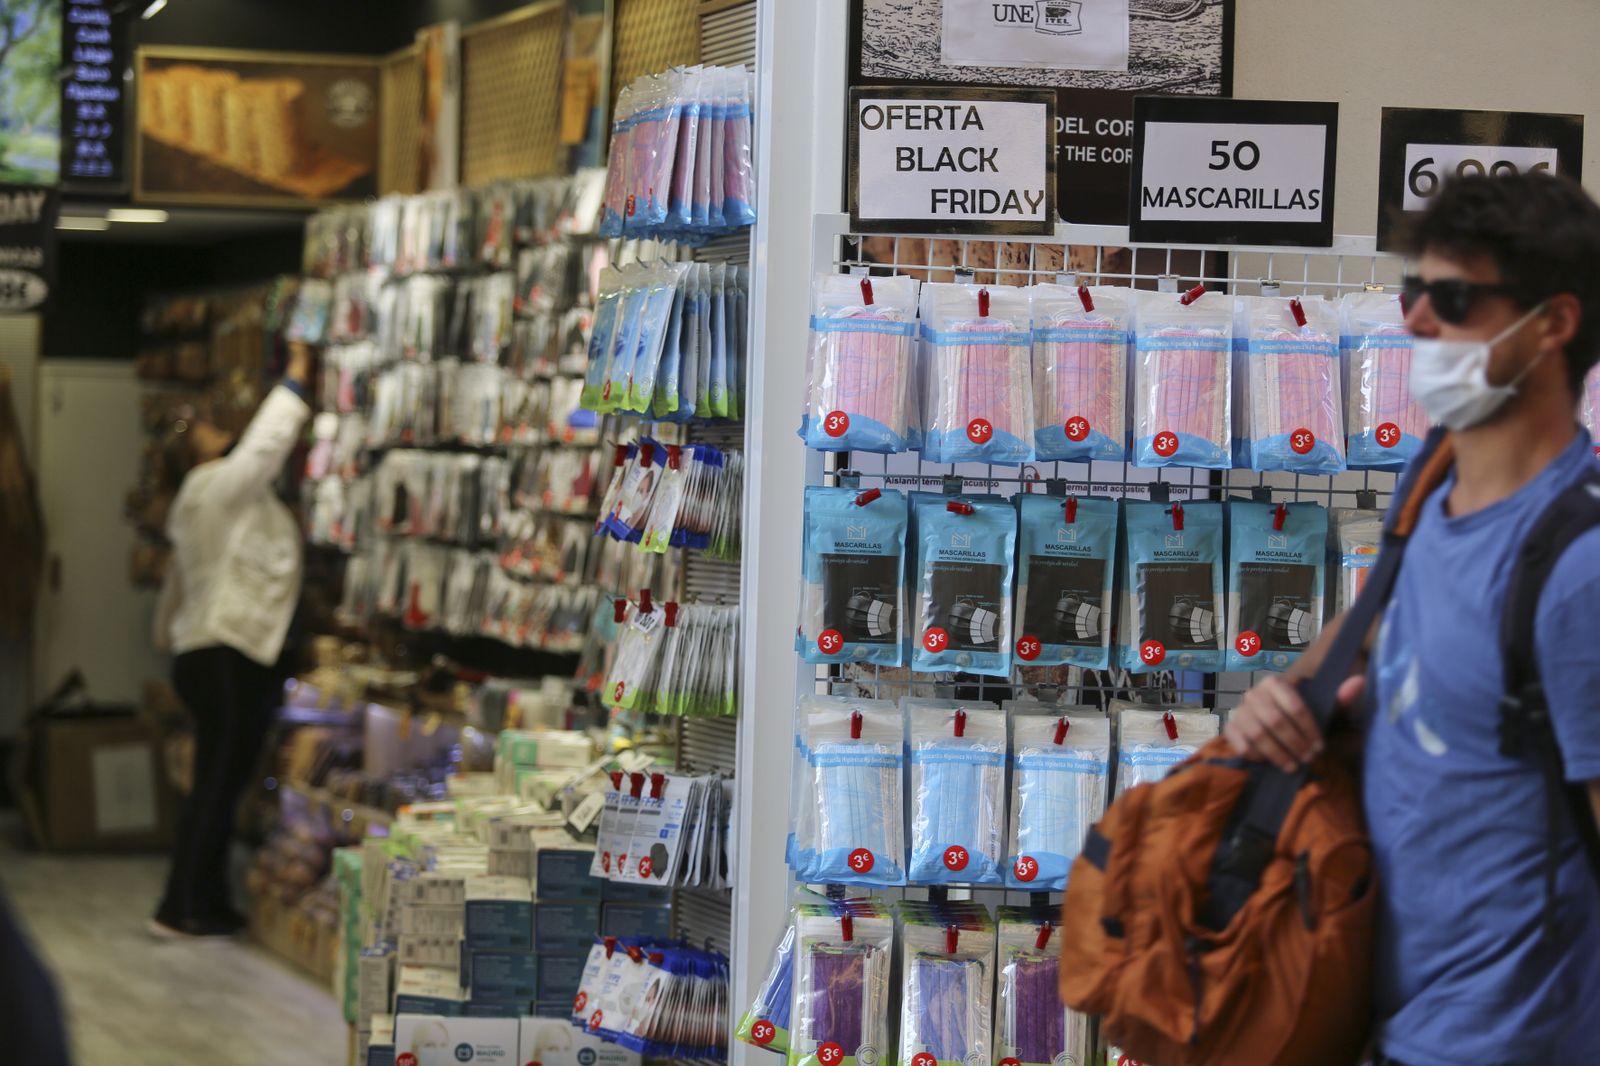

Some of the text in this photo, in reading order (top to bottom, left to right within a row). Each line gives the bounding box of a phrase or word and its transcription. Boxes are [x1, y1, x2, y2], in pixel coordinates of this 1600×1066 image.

[992, 4, 1034, 23] UNE
[861, 105, 984, 131] OFERTA
[896, 147, 999, 172] BLACK
[1065, 146, 1097, 162] THE
[1209, 140, 1260, 171] 50
[931, 189, 1044, 215] FRIDAY
[1142, 186, 1321, 210] MASCARILLAS
[828, 416, 845, 430] 3€
[1069, 421, 1085, 436] 3€
[971, 424, 988, 437] 3€
[1380, 428, 1396, 442] 3€
[1157, 436, 1175, 450] 3€
[1295, 434, 1311, 448] 3€
[1092, 484, 1107, 492] and
[834, 541, 882, 549] MASCARILLAS
[1045, 543, 1092, 552] MASCARILLAS
[939, 549, 986, 557] MASCARILLAS
[1255, 550, 1302, 558] MASCARILLAS
[823, 635, 838, 649] 3€
[928, 633, 944, 647] 3€
[1240, 637, 1255, 651] 3€
[1020, 641, 1037, 654] 3€
[1144, 646, 1161, 659] 3€
[854, 853, 869, 868] 3€
[949, 851, 964, 865] 3€
[755, 1025, 772, 1038] 3€
[822, 1048, 839, 1061] 3€
